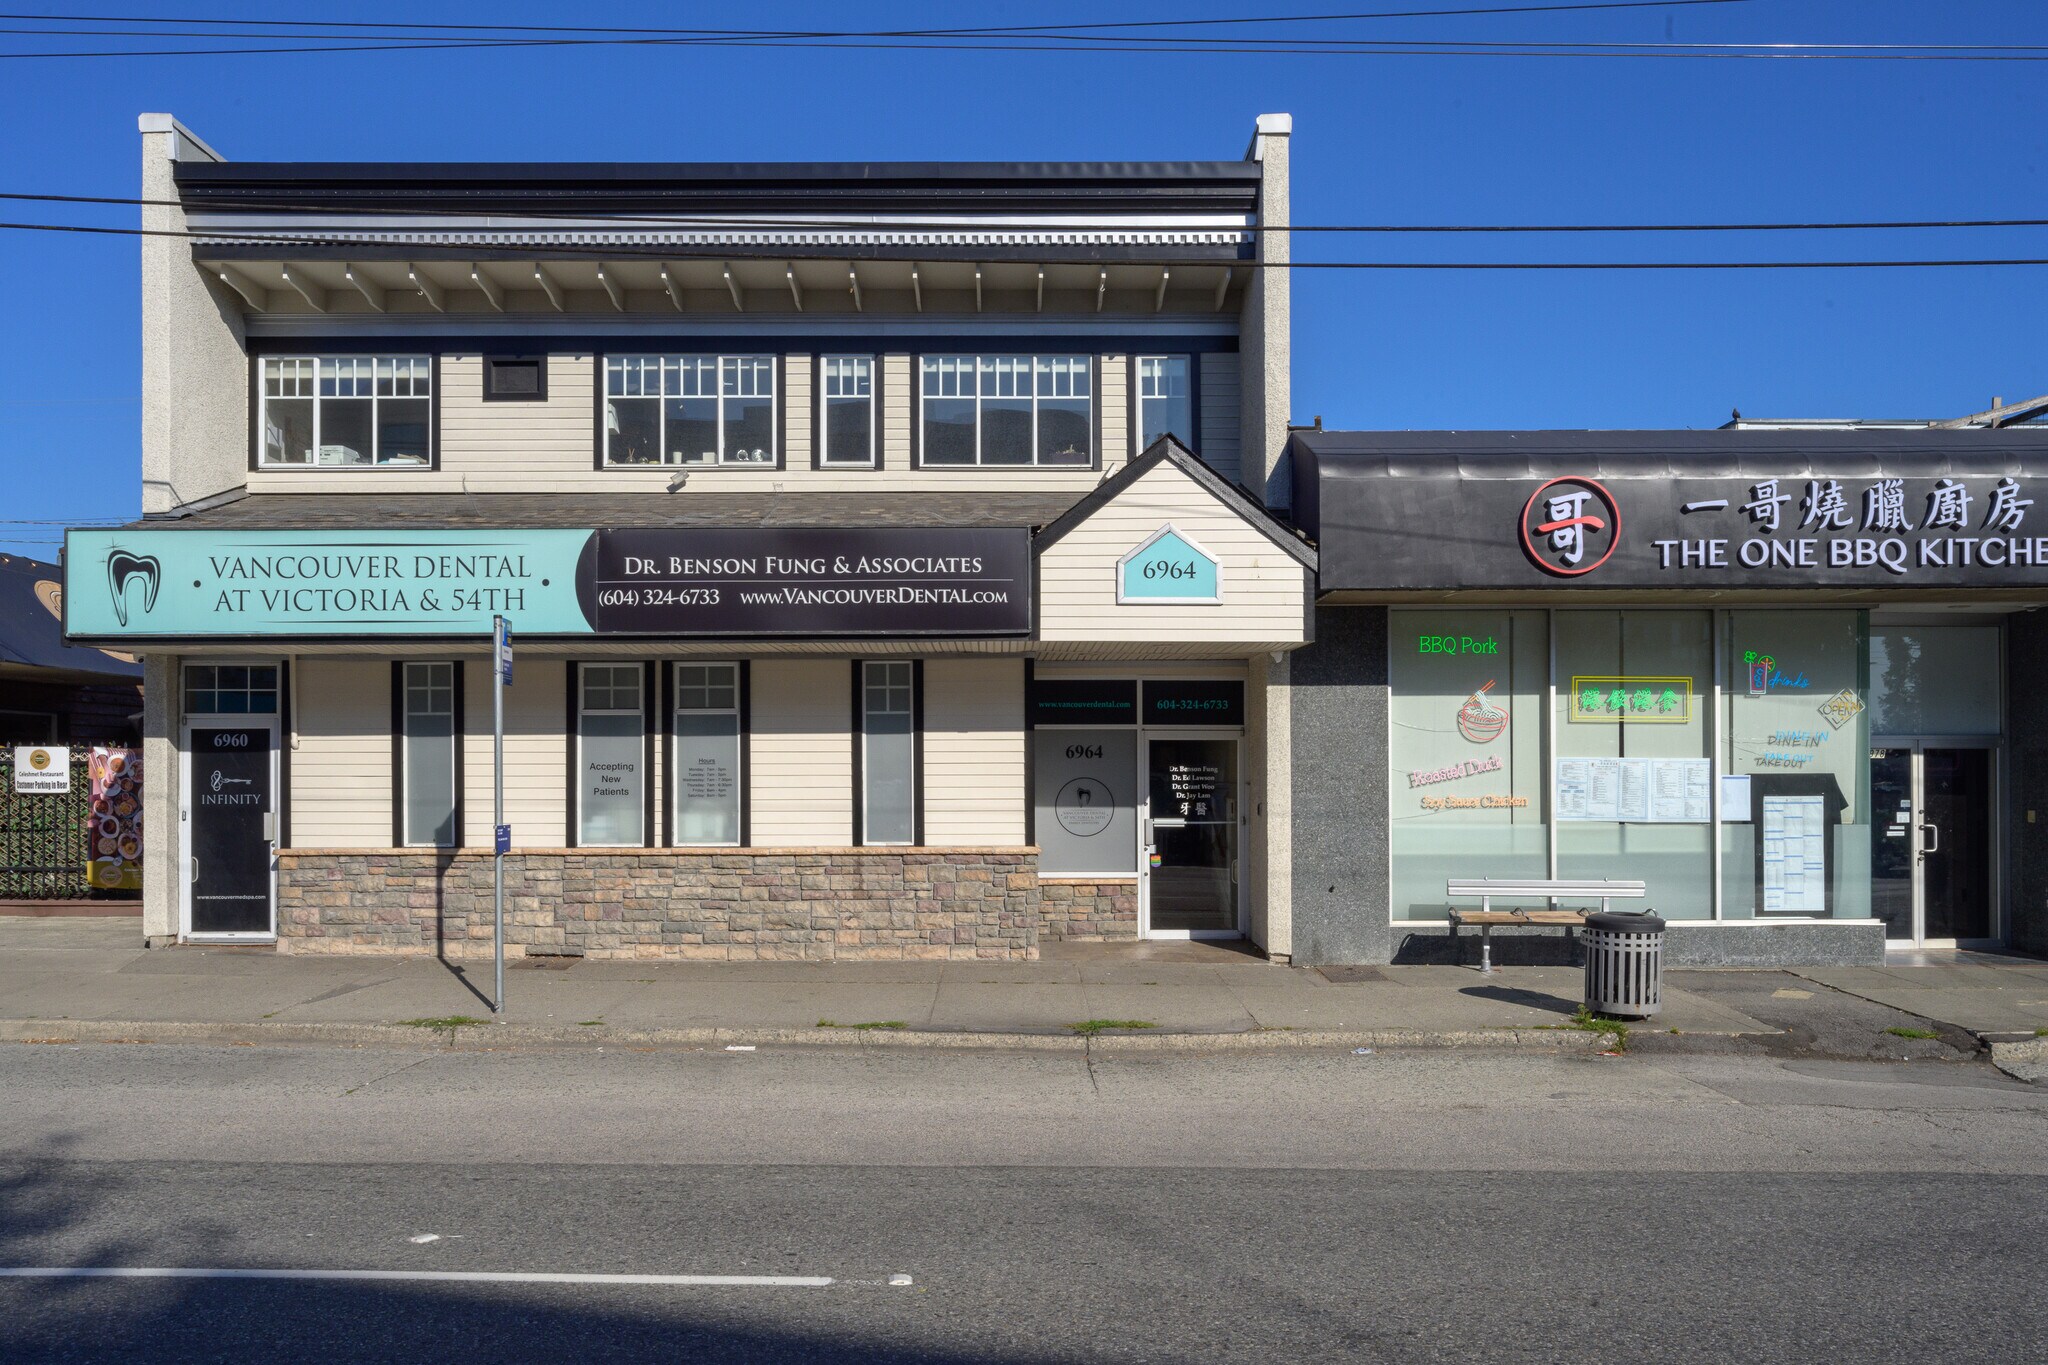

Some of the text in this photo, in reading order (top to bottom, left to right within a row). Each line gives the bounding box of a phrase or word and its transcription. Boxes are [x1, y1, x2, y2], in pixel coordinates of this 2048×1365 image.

[1687, 478, 2035, 531] 一哥燒臘廚房
[1537, 491, 1605, 563] 哥
[1655, 537, 2048, 573] THE ONE BBQ KITCHE
[209, 555, 532, 579] VANCOUVER DENTAL
[833, 556, 851, 574] &
[1143, 560, 1197, 579] 6964
[213, 588, 526, 612] AT VICTORIA & 54TH
[598, 589, 720, 607] (604) 324-6733
[1419, 636, 1498, 655] BBQ Pork
[1767, 671, 1810, 688] drinks
[1038, 700, 1131, 708] www.vancouverdental.com
[1156, 699, 1229, 710] 604-324-6733
[213, 733, 249, 747] 6960
[1775, 731, 1830, 742] DINE IN
[1065, 744, 1103, 759] 6964
[1764, 751, 1814, 762] TAKE OUT
[589, 762, 634, 772] Accepting
[1411, 754, 1504, 786] Roasted Duck
[17, 780, 67, 790] Customer Parking in Rear
[601, 775, 621, 783] New
[201, 794, 261, 804] INFINITY
[593, 787, 629, 796] Patients
[1180, 802, 1207, 815] 牙醫
[1422, 793, 1528, 810] Soy Sauce Chicken
